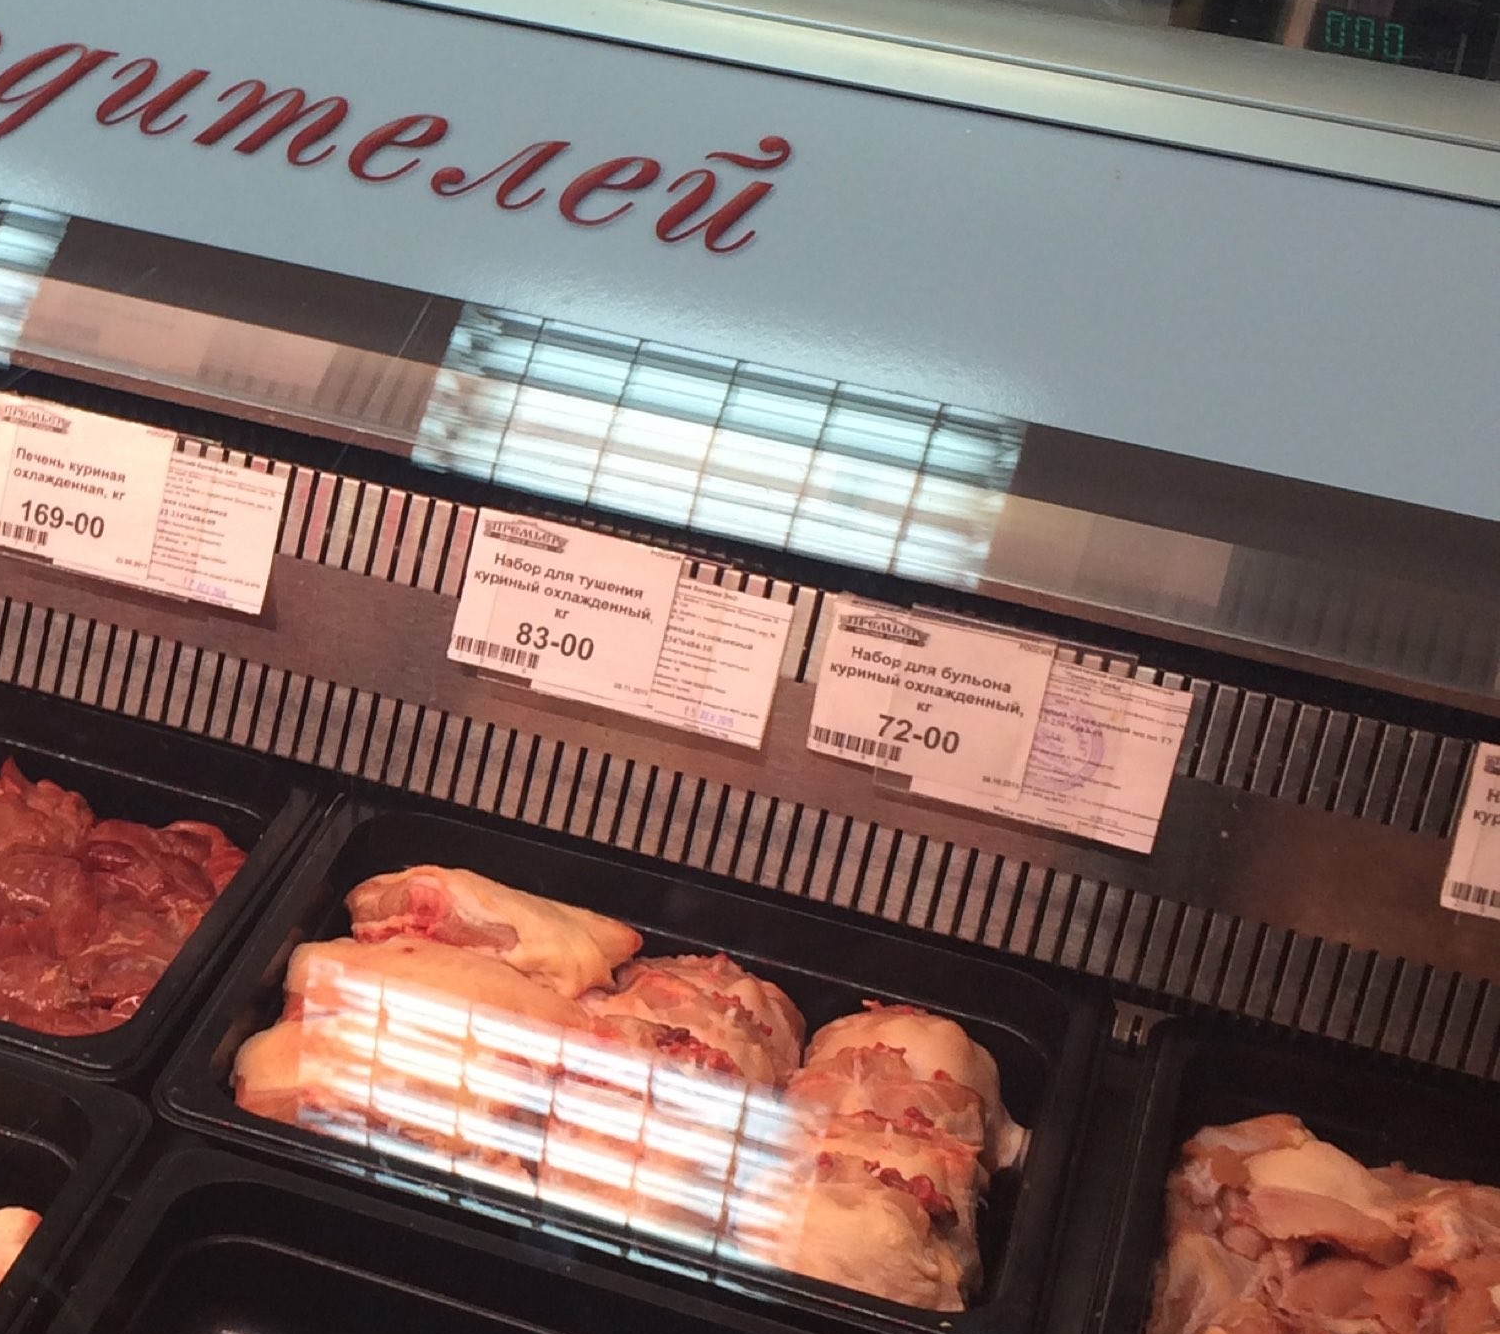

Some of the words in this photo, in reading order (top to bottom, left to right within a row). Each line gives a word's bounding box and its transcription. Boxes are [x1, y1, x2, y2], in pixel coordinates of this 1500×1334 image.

[13, 467, 108, 500] охлажденная,
[112, 489, 126, 503] кг
[16, 446, 65, 470] Печень
[69, 459, 126, 484] куриная
[21, 499, 106, 540] 169-00
[473, 568, 541, 595] куриный
[544, 585, 653, 624] охлажденный,
[494, 552, 543, 577] Набор
[544, 566, 574, 584] для
[578, 573, 644, 600] тушения
[554, 607, 570, 620] кг
[515, 621, 595, 661] 83-00
[829, 660, 901, 690] куриный
[903, 678, 1025, 719] охлажденный,
[850, 644, 901, 671] Набор
[903, 658, 937, 677] для
[940, 665, 1012, 696] бульона
[916, 700, 933, 714] кг
[877, 712, 961, 755] 72-00
